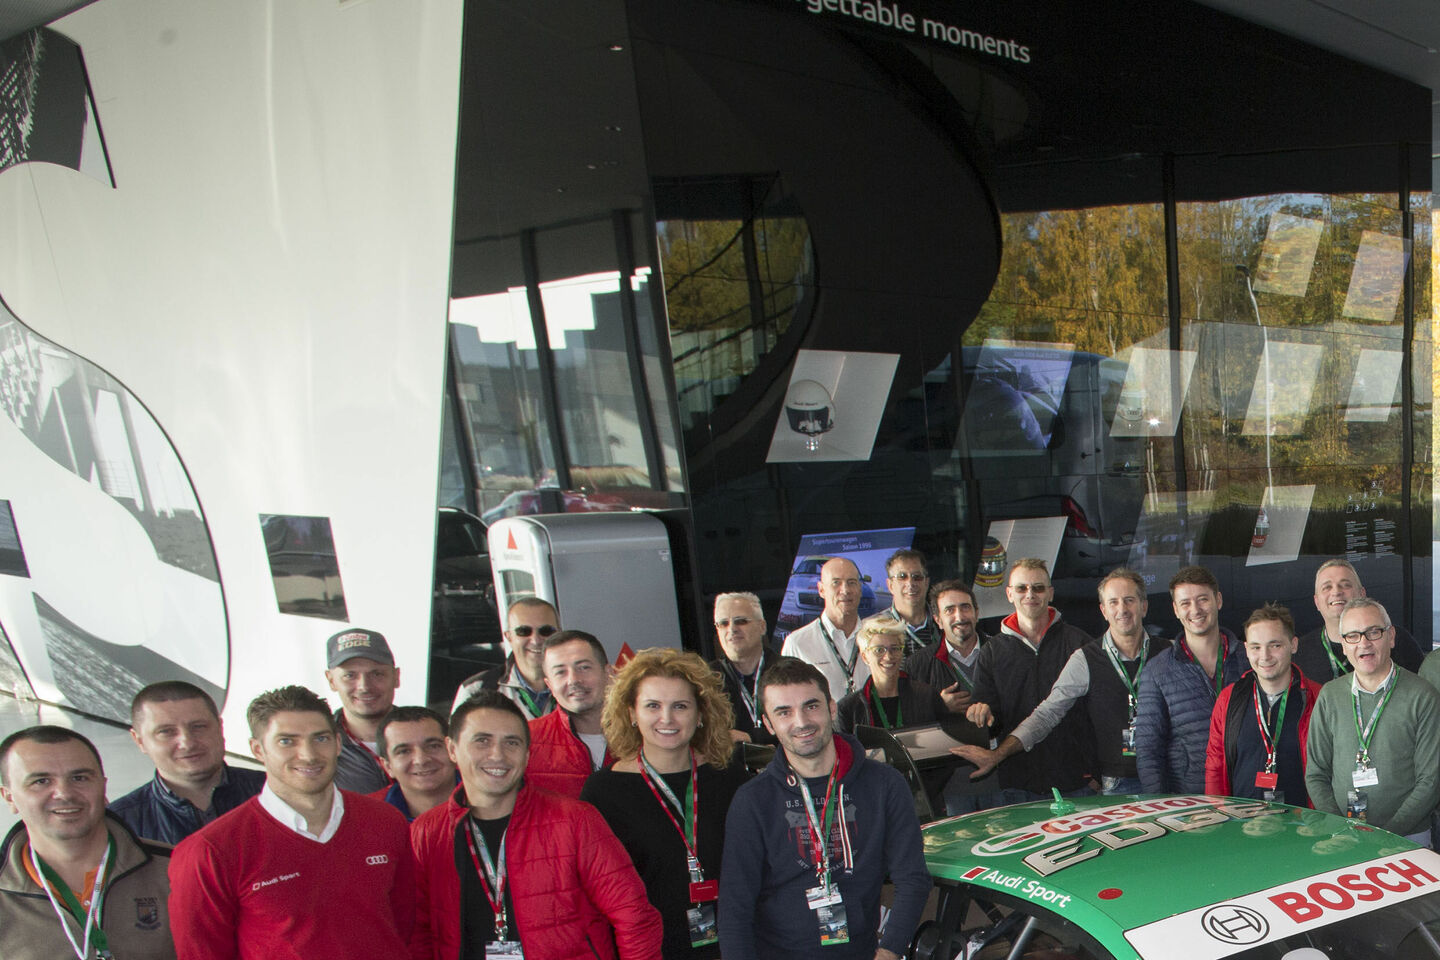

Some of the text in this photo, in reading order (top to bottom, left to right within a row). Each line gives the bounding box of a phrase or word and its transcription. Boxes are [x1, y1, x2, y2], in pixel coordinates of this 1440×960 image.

[923, 18, 1031, 63] moments
[785, 800, 803, 808] U.S.
[1041, 795, 1224, 834] Castrol
[1022, 802, 1289, 877] EDGE
[261, 871, 300, 887] Audi Sport
[985, 869, 1071, 908] Audi Sport
[1267, 858, 1439, 924] BOSCH
